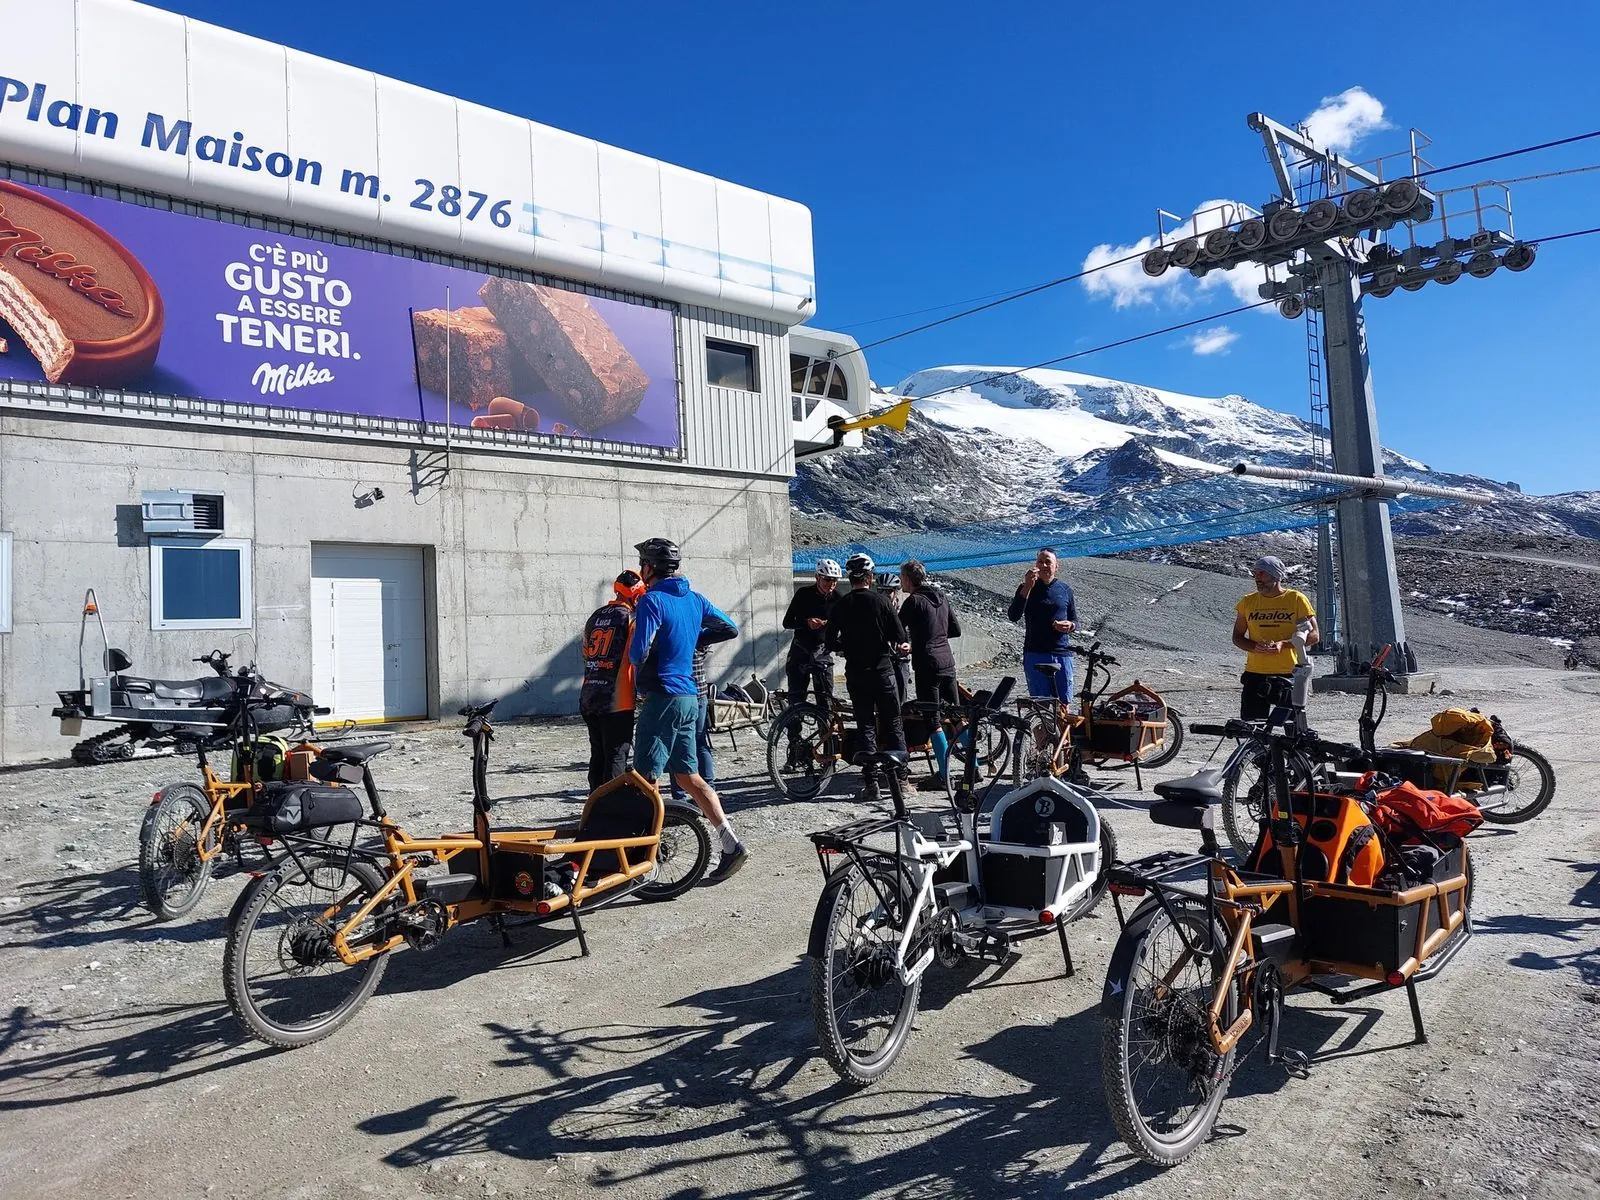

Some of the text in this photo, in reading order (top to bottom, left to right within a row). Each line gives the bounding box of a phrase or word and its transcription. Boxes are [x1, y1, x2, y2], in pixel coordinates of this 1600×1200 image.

[0, 76, 512, 228] Plan Maison m. 2876
[291, 250, 329, 274] PIÙ
[224, 262, 352, 307] GUSTO
[237, 294, 342, 326] A ESSERE
[215, 313, 362, 360] TENERI.
[251, 361, 335, 396] Milka
[1247, 610, 1295, 621] Maalox
[587, 626, 615, 659] 31
